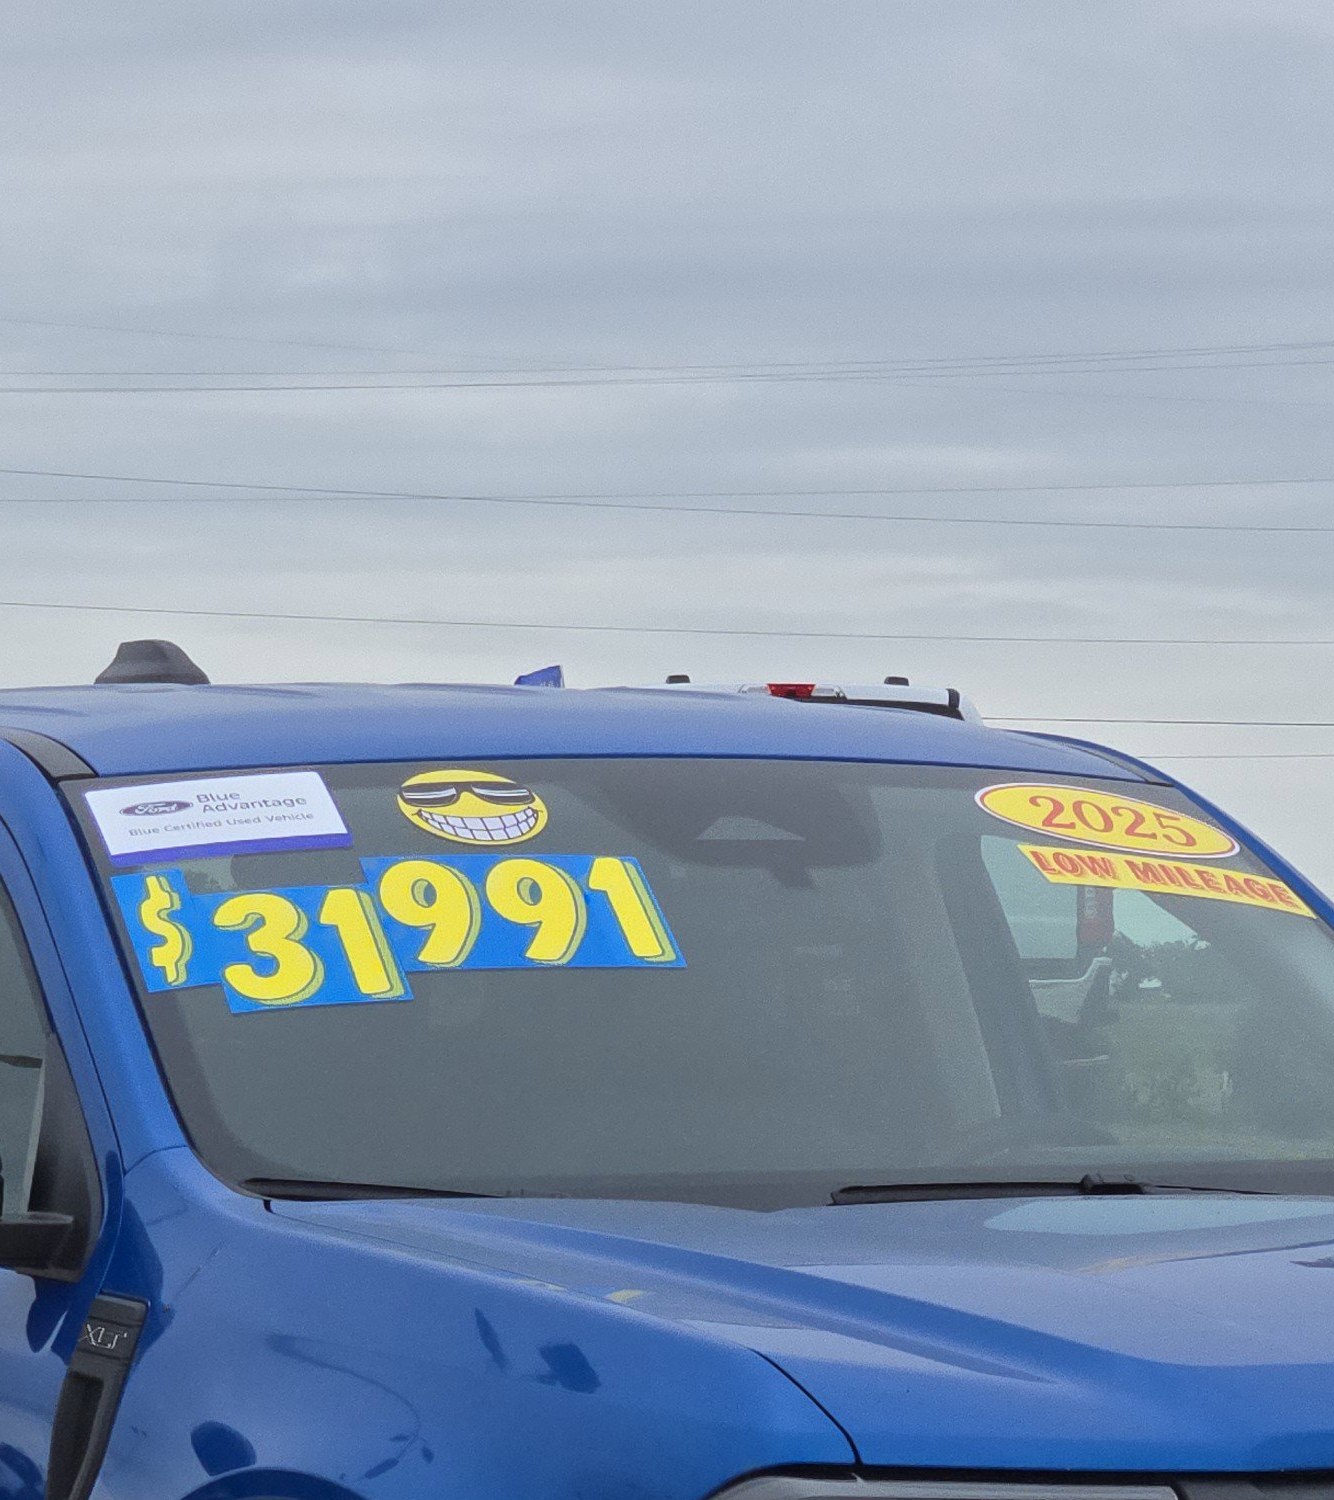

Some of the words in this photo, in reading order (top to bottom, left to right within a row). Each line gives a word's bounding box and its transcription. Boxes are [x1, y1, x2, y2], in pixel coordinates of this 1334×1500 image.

[196, 791, 241, 804] Blue
[202, 797, 307, 813] Advantage
[128, 826, 160, 837] Blue
[164, 820, 223, 833] Certified
[226, 815, 261, 827] Used
[263, 812, 314, 824] Vehicle
[1028, 795, 1197, 847] 2025
[1029, 849, 1117, 880] LOW
[1124, 859, 1305, 910] MILEAGE
